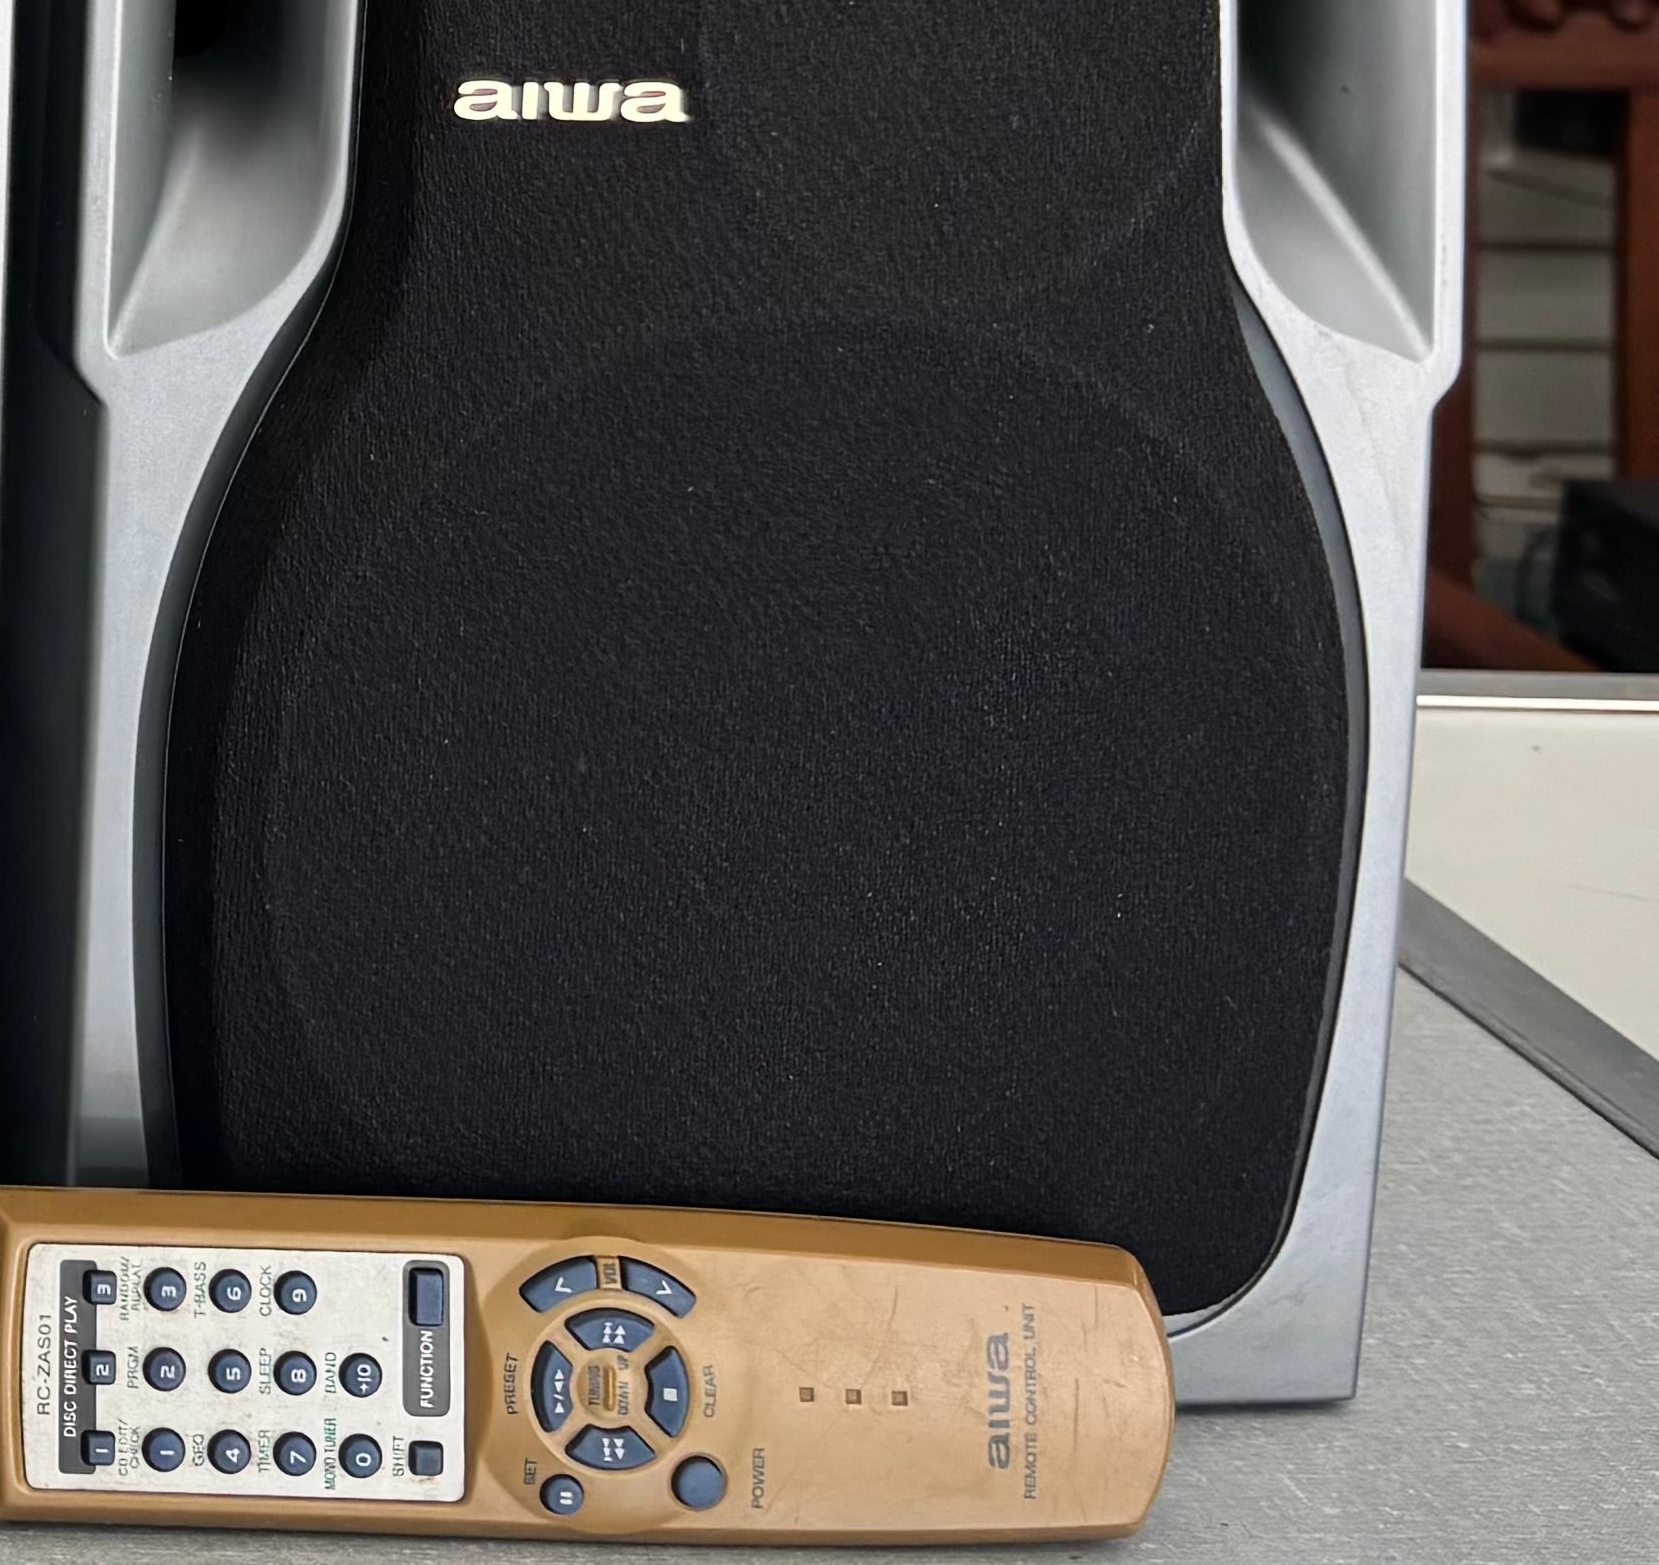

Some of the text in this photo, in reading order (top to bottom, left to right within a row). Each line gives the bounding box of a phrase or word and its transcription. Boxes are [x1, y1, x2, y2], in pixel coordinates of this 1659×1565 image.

[452, 79, 691, 124] aiwa
[97, 1283, 112, 1296] 3
[161, 1285, 178, 1299] 3
[193, 1260, 207, 1320] T-BASS
[226, 1286, 242, 1301] 6
[258, 1265, 273, 1318] CLOCK
[291, 1287, 308, 1304] 9
[36, 1313, 53, 1416] RC-ZAS01
[63, 1295, 79, 1439] DISC DIRECT PLAY
[95, 1363, 110, 1376] 2
[160, 1364, 175, 1379] 2
[226, 1366, 242, 1381] 5
[258, 1347, 273, 1396] SLEEP
[290, 1368, 308, 1383] 8
[324, 1351, 338, 1395] BAND
[356, 1363, 372, 1395] +10
[419, 1329, 435, 1409] FUNCTION
[503, 1351, 520, 1416] PRESET
[702, 1363, 716, 1419] CLEAR
[985, 1331, 1012, 1470] aiwa
[1022, 1302, 1038, 1501] REMOTE CONTROL UNIT
[225, 1447, 241, 1464] 4
[289, 1449, 308, 1465] 7
[355, 1452, 372, 1467] 0
[750, 1447, 767, 1510] POWER
